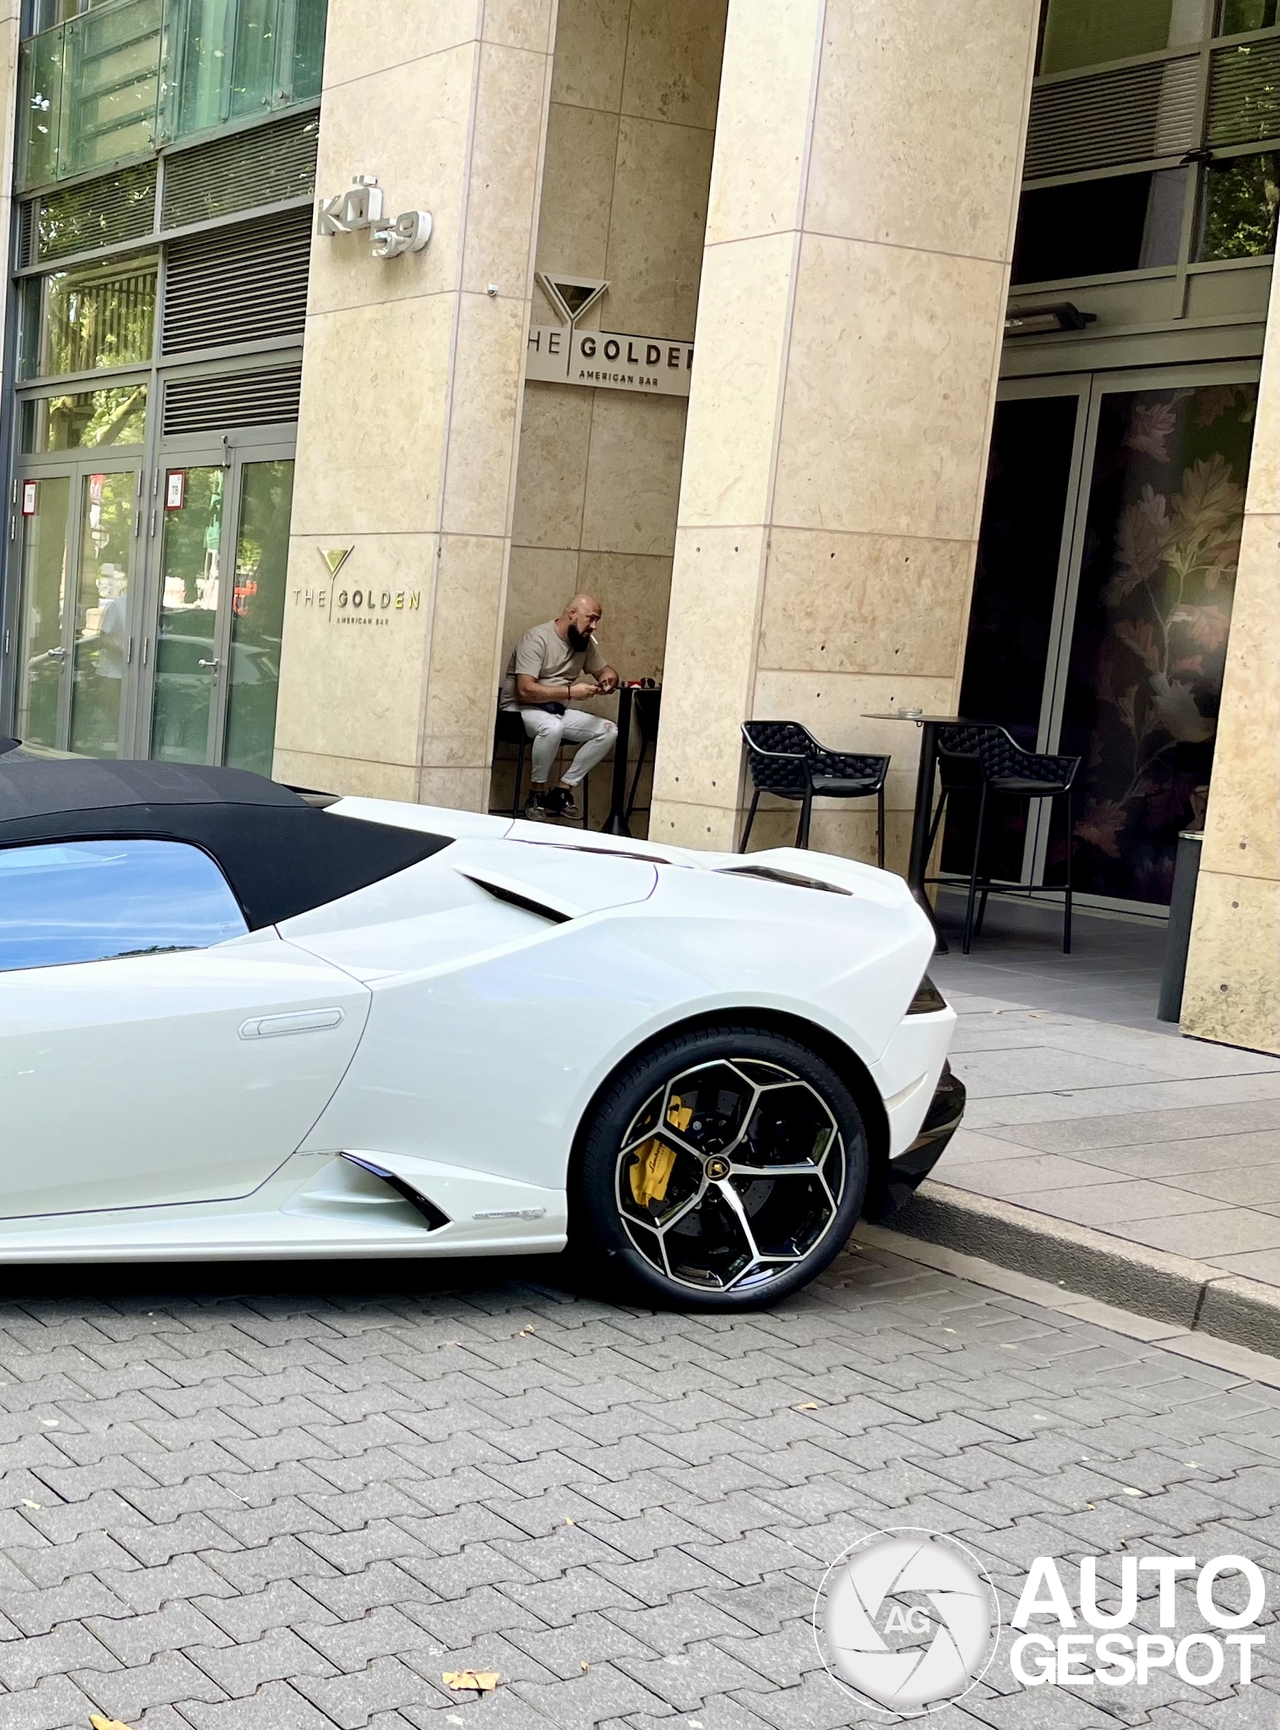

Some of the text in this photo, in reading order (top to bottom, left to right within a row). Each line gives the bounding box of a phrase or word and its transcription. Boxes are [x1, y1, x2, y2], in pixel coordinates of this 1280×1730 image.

[527, 330, 561, 355] HE
[579, 370, 659, 387] AMERICAN BAR
[293, 589, 420, 610] THE GOLDEN
[337, 617, 372, 625] AMERICAN
